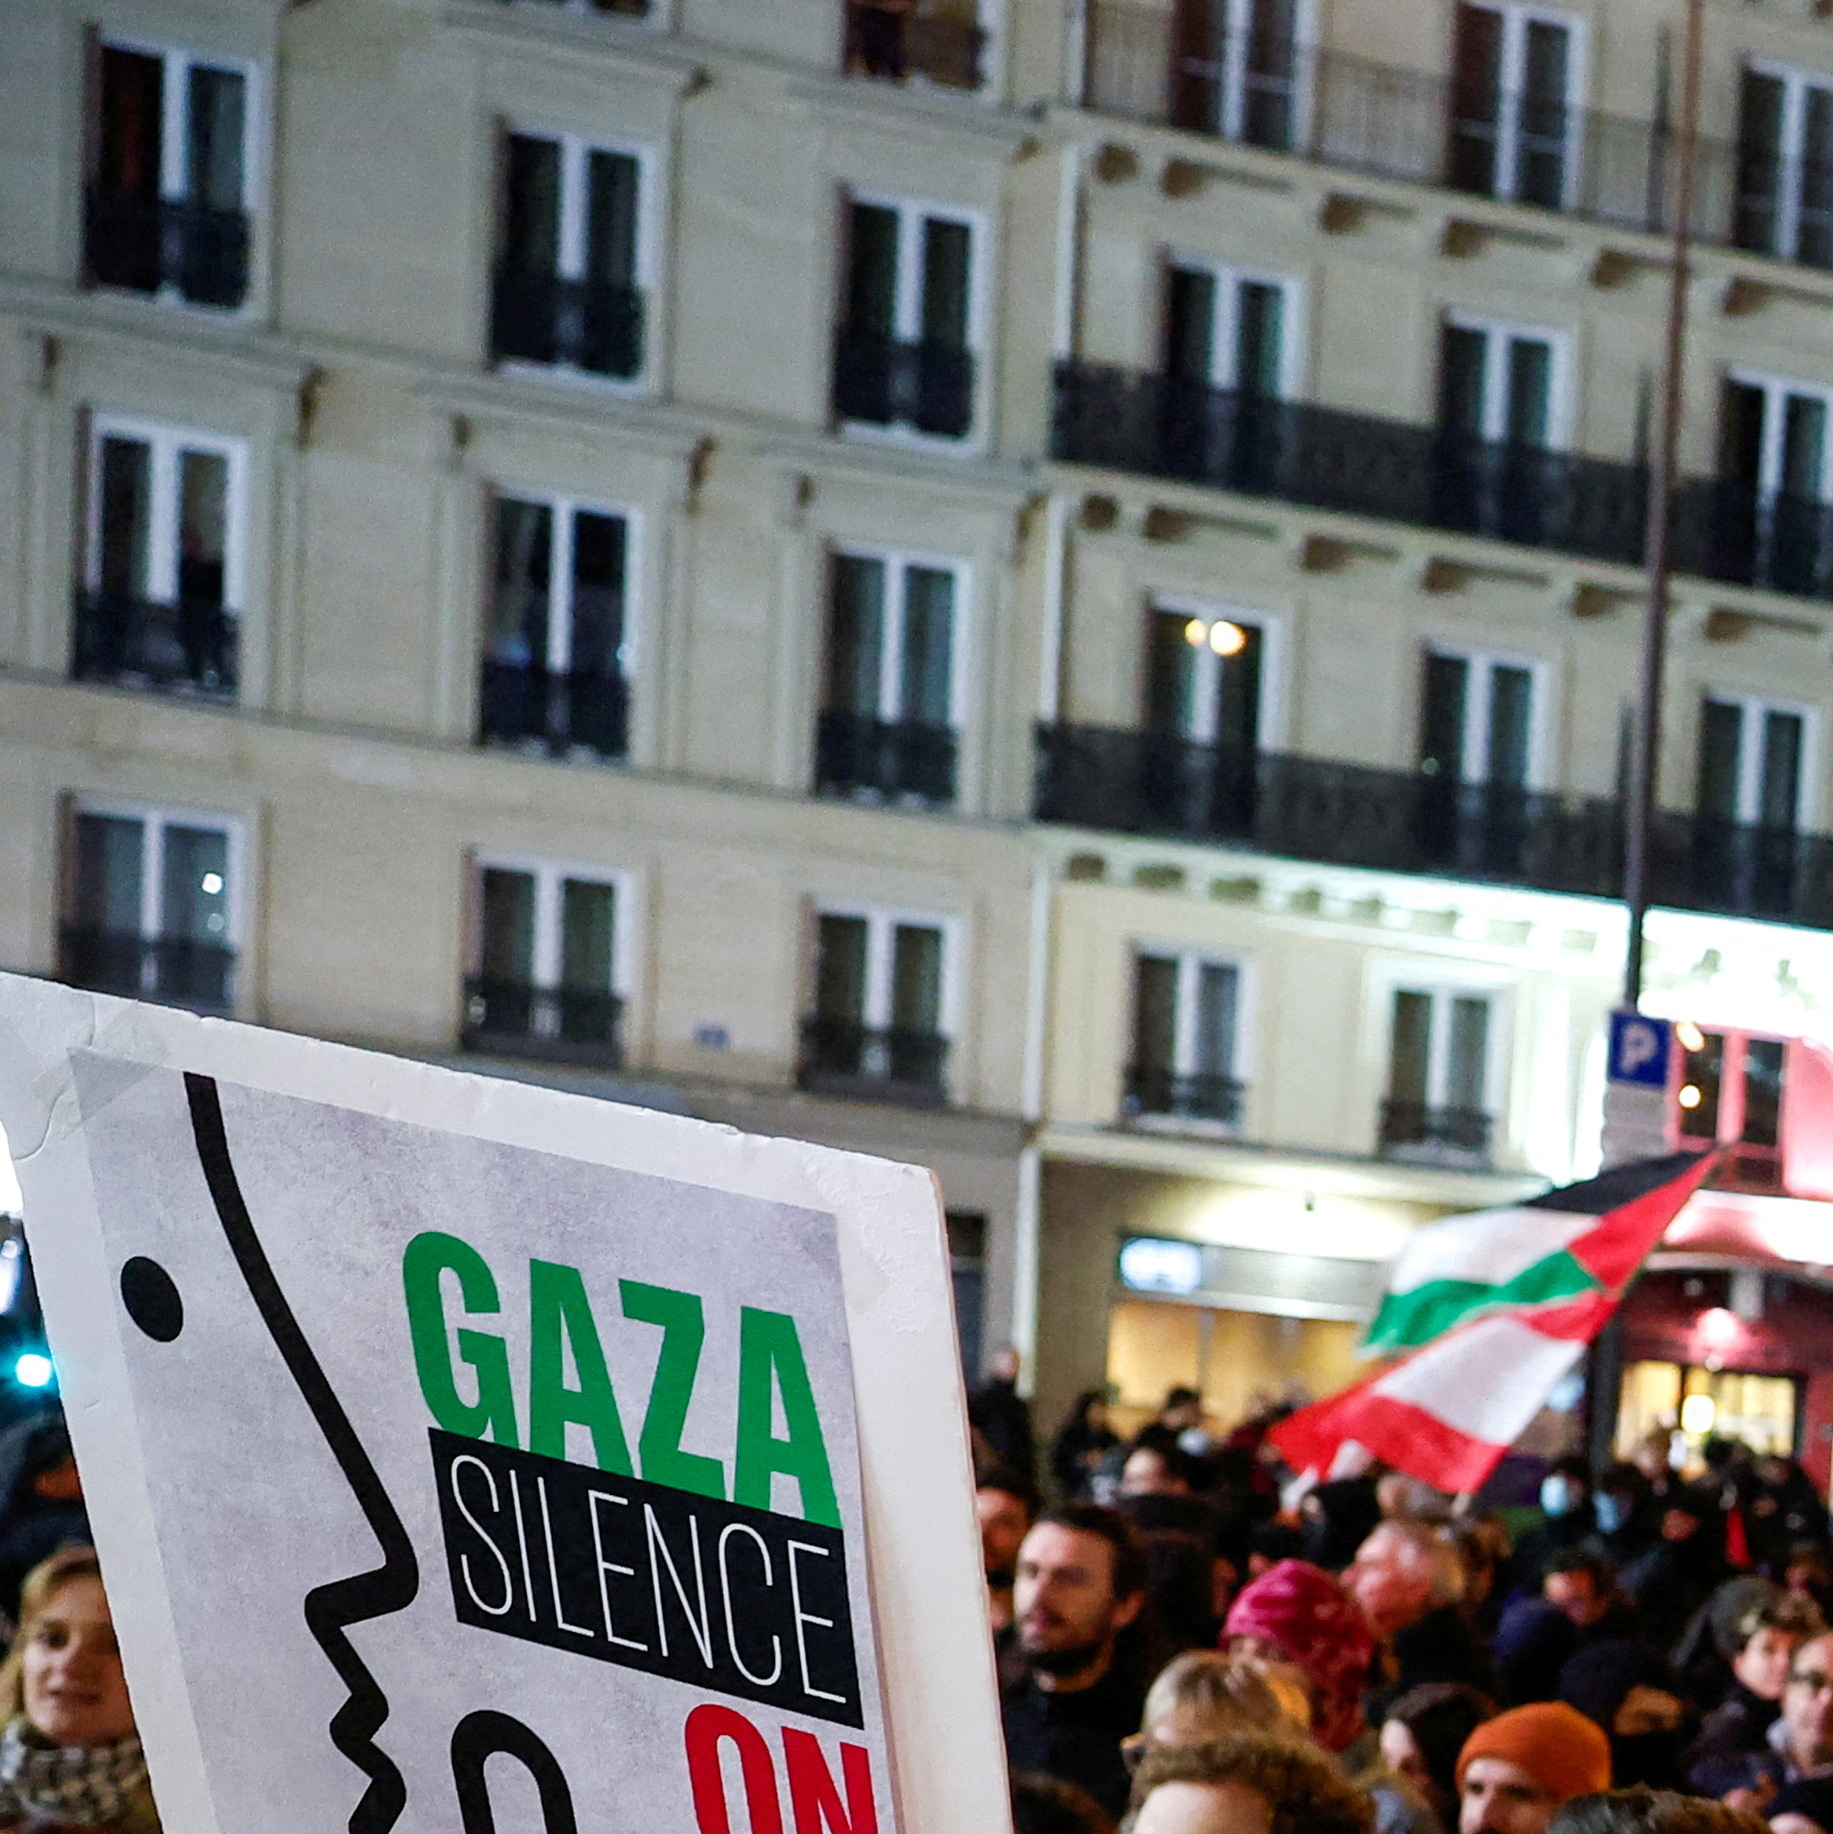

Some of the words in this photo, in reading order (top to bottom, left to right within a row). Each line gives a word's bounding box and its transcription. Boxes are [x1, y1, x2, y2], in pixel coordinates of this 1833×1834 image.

[1620, 1023, 1659, 1075] P
[402, 1231, 844, 1530] GAZA
[450, 1454, 847, 1704] SILENCE
